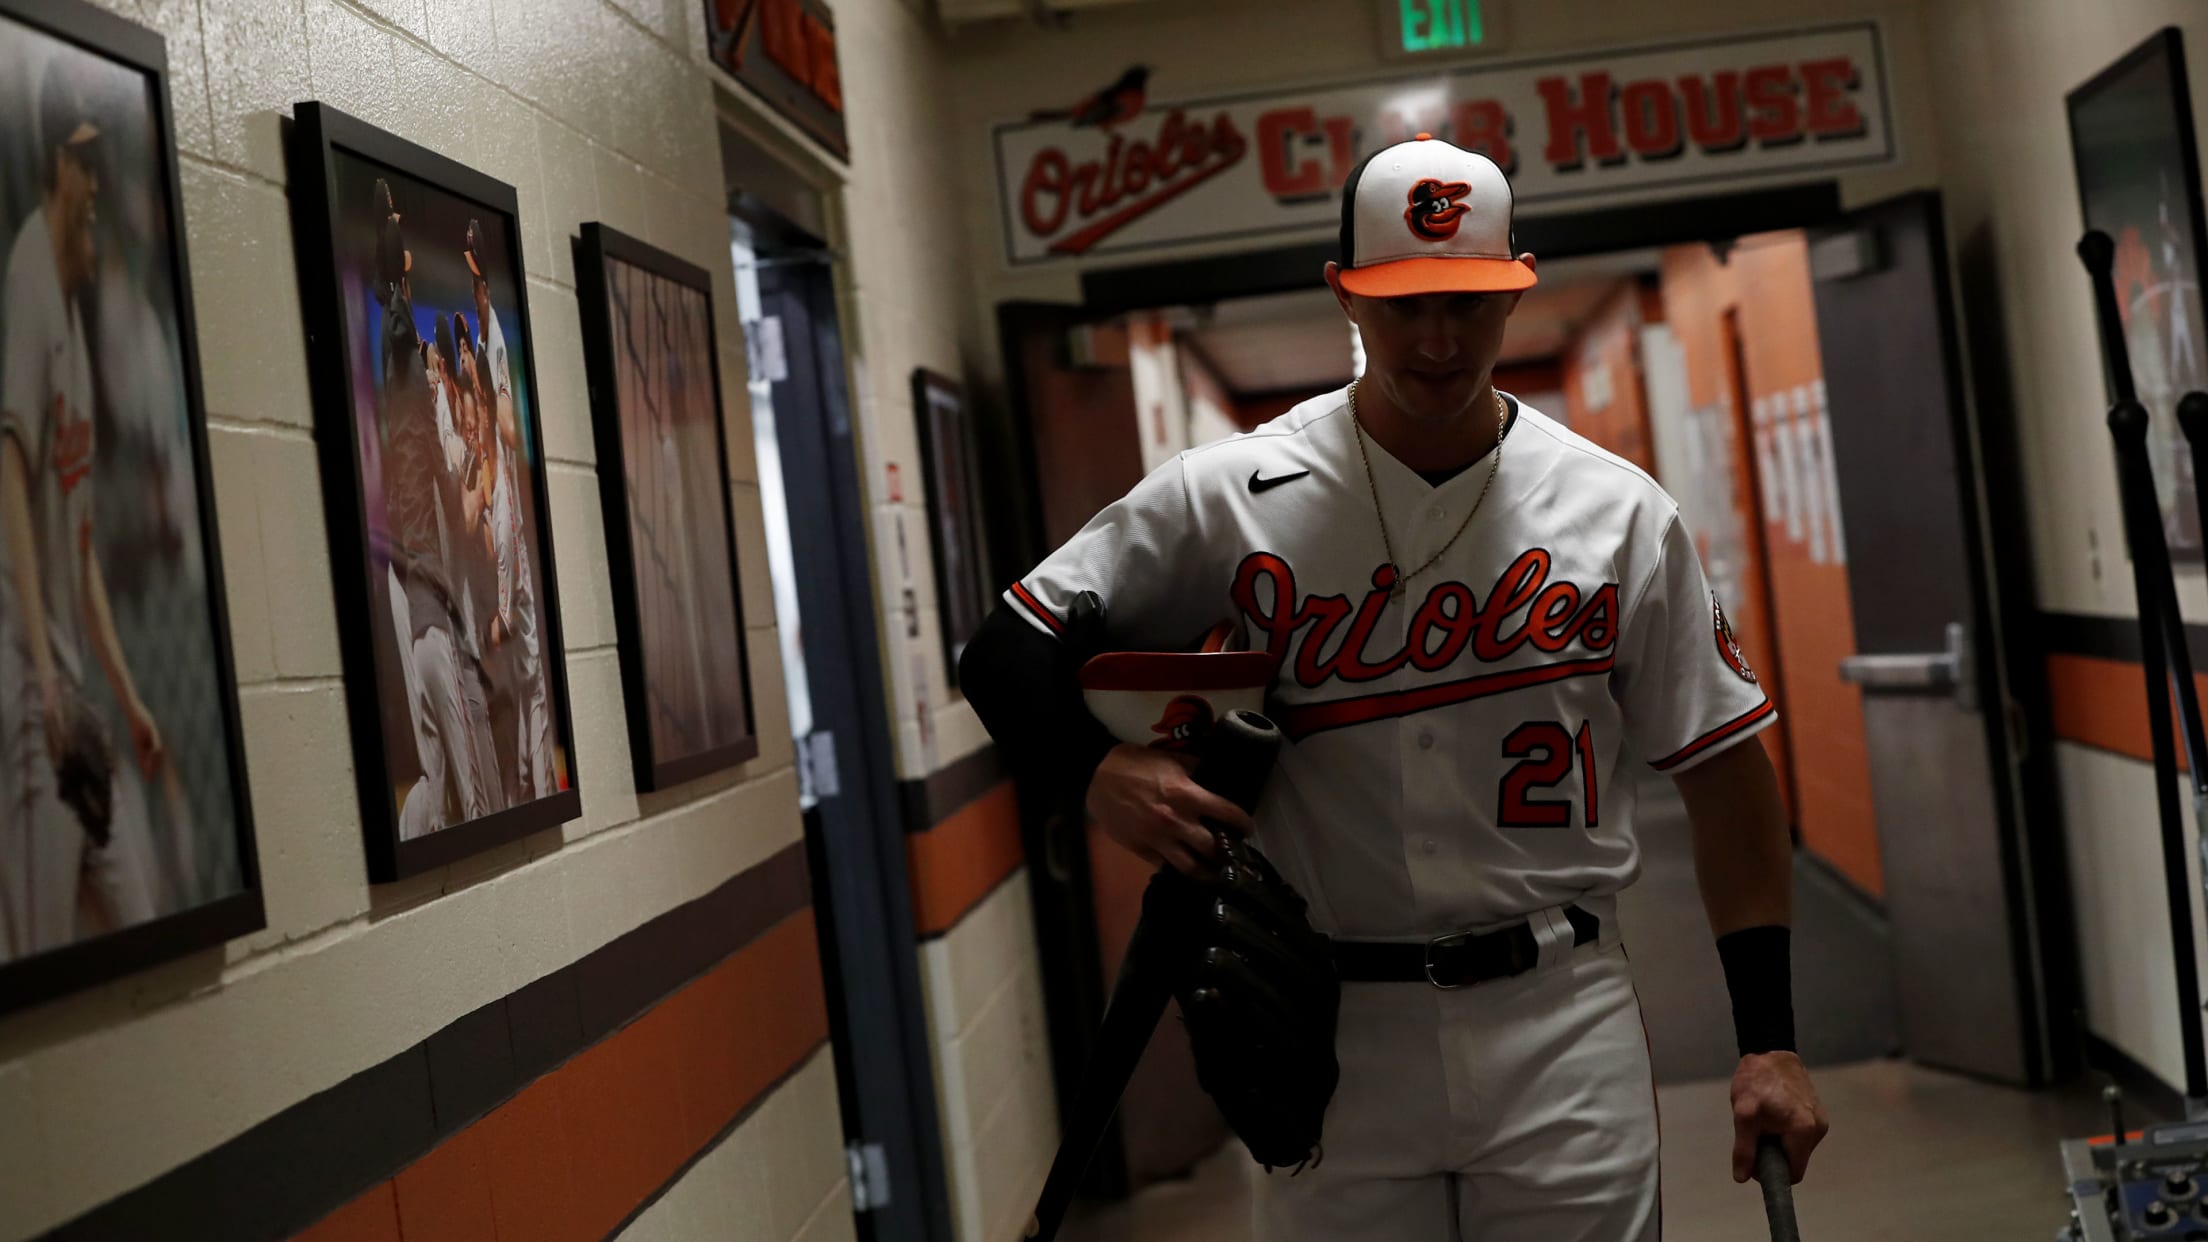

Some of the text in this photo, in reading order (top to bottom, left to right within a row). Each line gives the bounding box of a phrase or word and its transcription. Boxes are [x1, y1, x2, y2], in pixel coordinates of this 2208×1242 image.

[1020, 107, 1247, 240] Orioles
[1231, 547, 1619, 692] Orioles
[1497, 719, 1599, 829] 21
